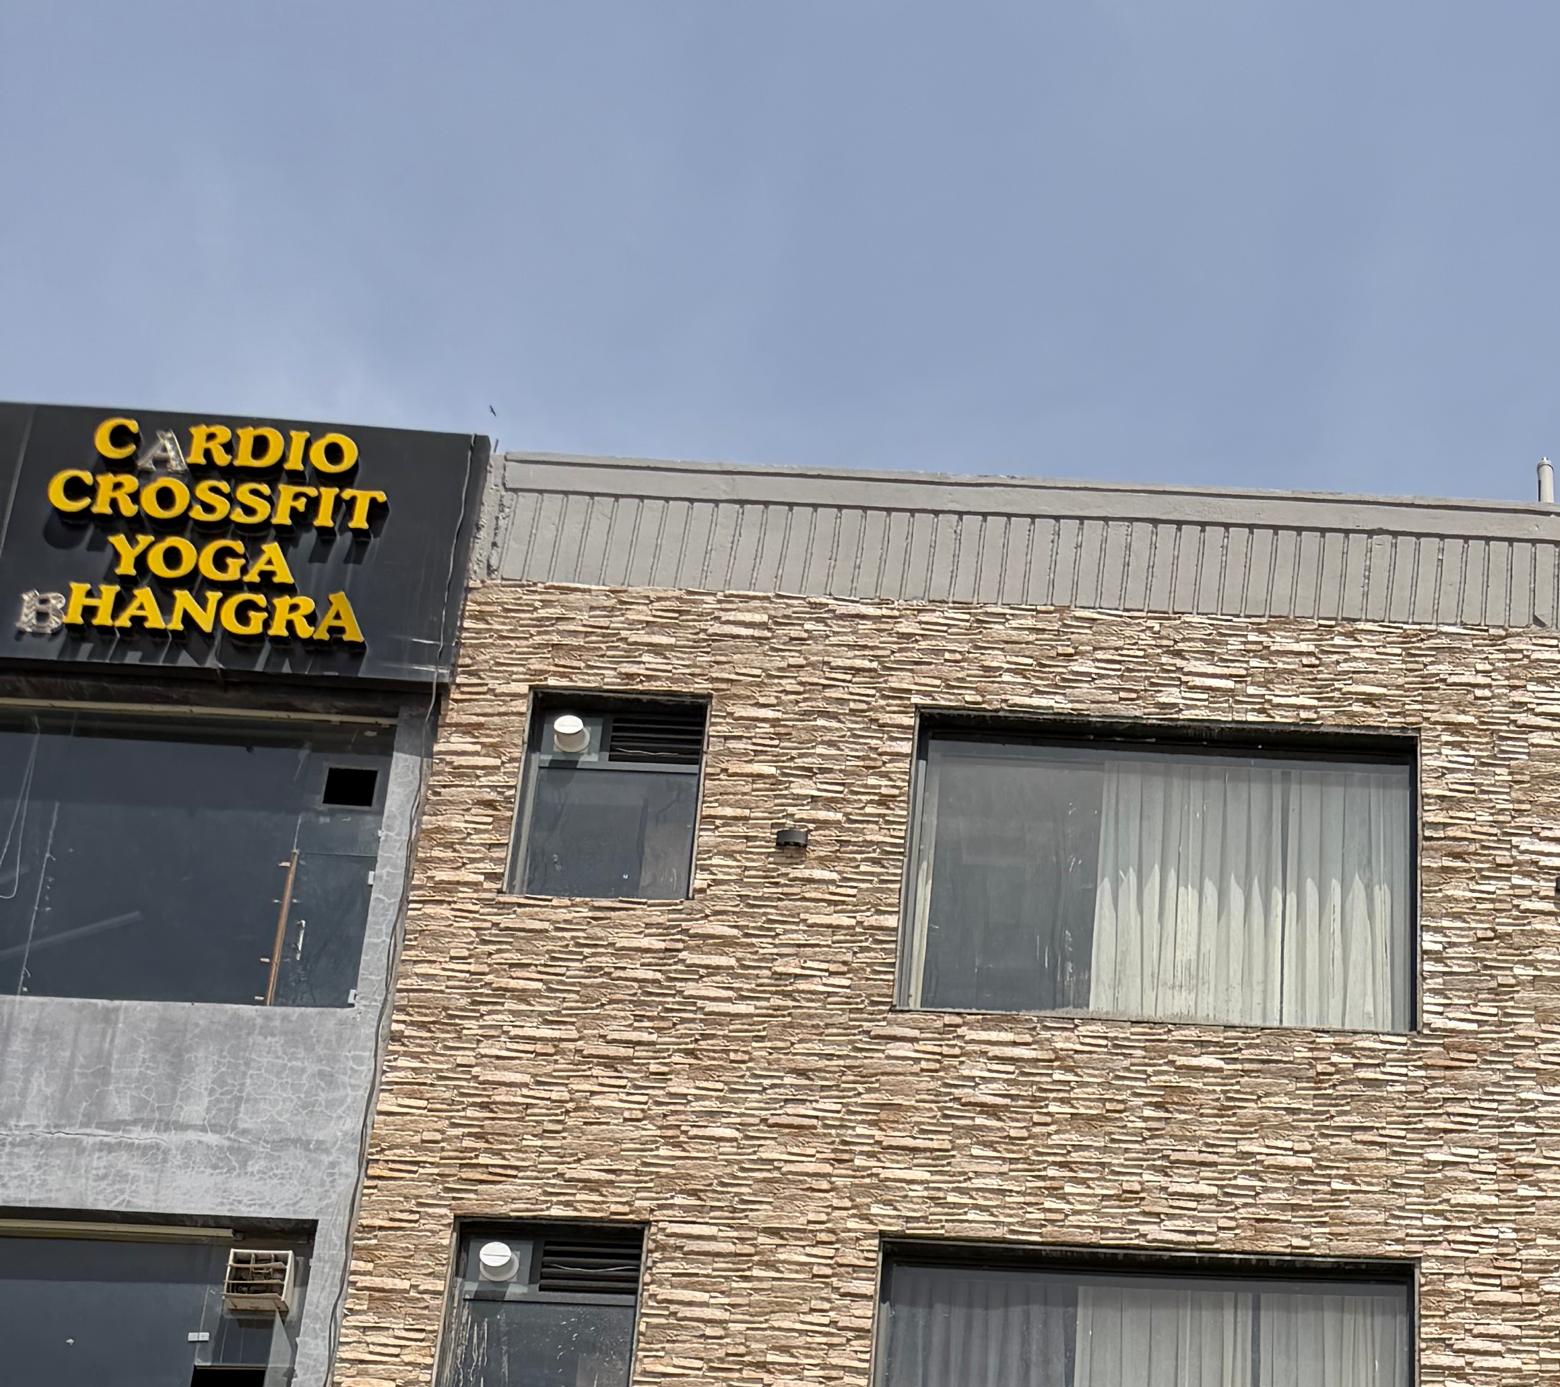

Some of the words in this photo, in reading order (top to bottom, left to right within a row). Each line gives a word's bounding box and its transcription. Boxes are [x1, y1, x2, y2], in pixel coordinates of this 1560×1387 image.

[94, 416, 360, 475] CARDIO
[47, 468, 388, 531] CROSSFIT
[108, 533, 295, 586] YOGA
[15, 581, 366, 644] BHANGRA
